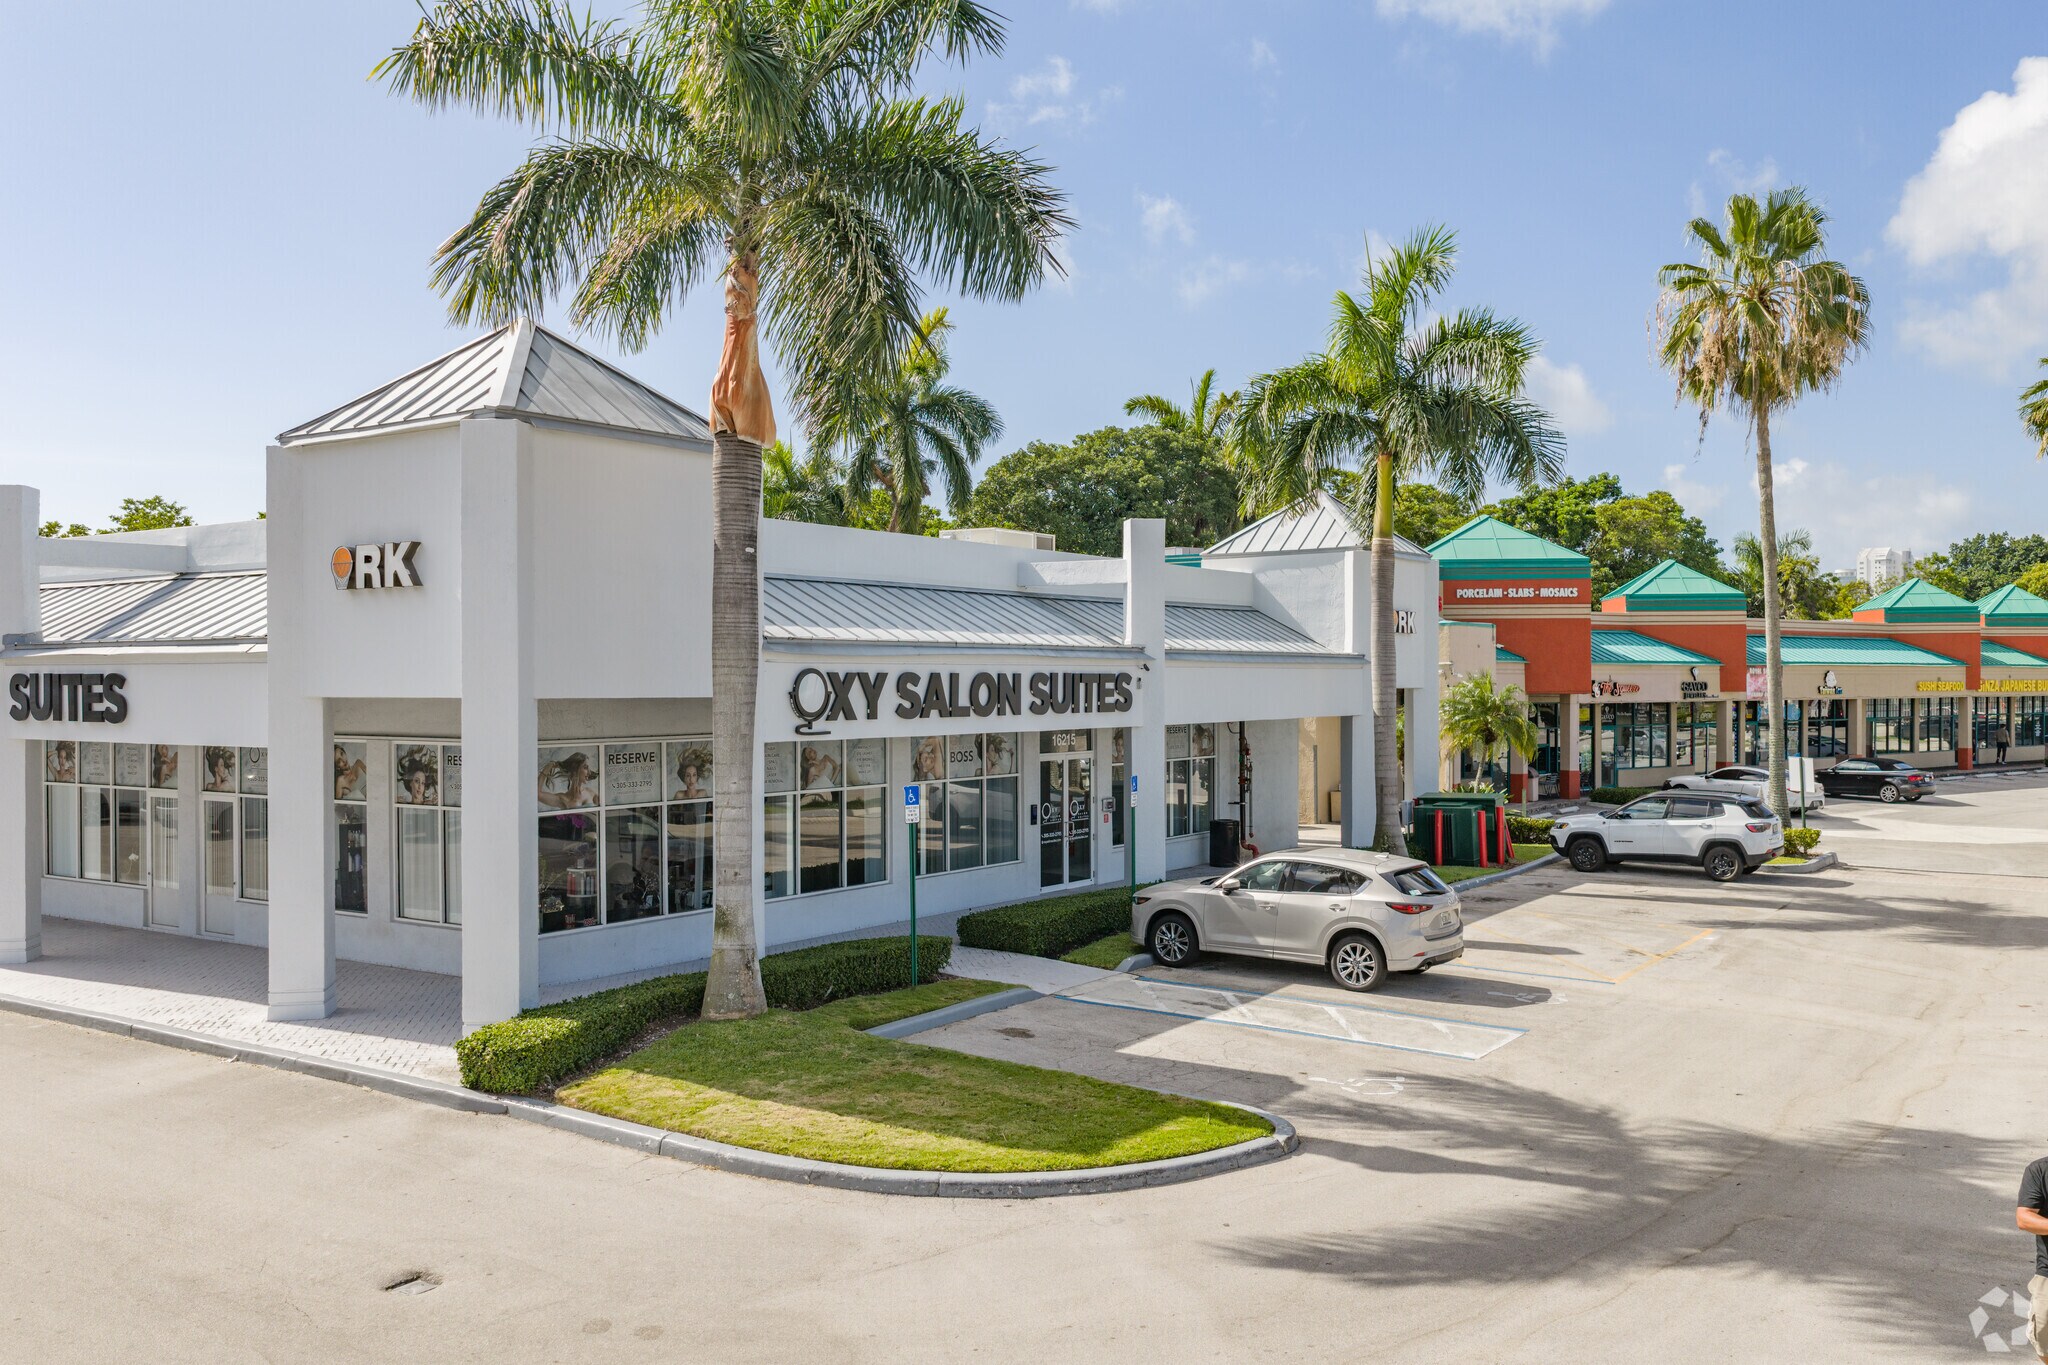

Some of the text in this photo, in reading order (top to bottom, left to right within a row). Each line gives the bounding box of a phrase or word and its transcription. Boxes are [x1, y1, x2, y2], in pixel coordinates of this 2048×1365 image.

[355, 541, 421, 590] RK
[1456, 588, 1503, 599] PORCELAIN
[1508, 588, 1534, 598] SLABS
[1540, 587, 1578, 598] MOSAICS
[1399, 610, 1416, 634] RK
[1917, 681, 1965, 691] SUSHI SEAFOOD
[2001, 679, 2036, 692] JAPANESE
[9, 673, 128, 724] SUITES
[895, 671, 1022, 719] SALON
[1029, 672, 1133, 716] SUITES
[1166, 726, 1187, 734] RESERVE
[1052, 734, 1076, 746] 16215
[608, 751, 656, 765] RESERVE
[950, 751, 974, 763] BOSS
